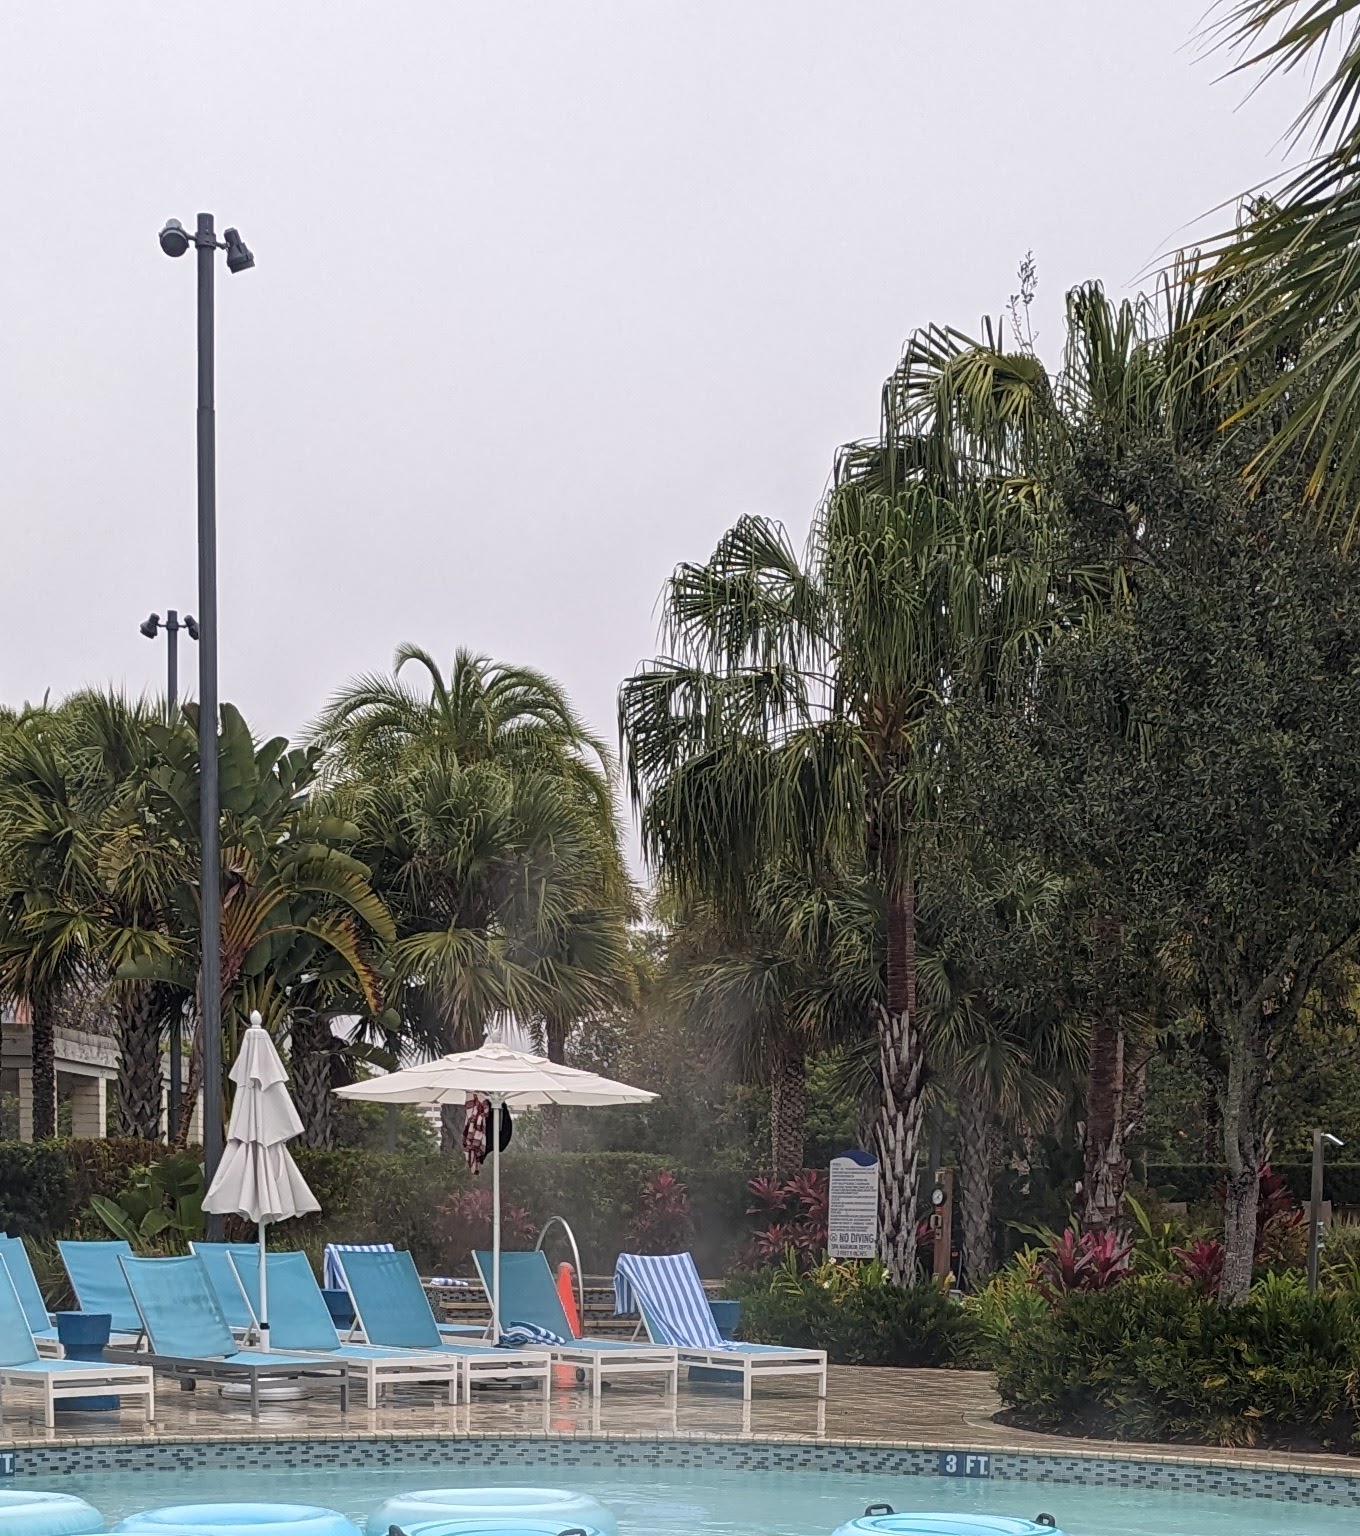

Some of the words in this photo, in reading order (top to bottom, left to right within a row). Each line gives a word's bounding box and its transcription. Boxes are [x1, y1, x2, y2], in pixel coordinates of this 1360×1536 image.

[839, 1233, 849, 1243] NO
[850, 1233, 874, 1243] DIVING
[946, 1454, 958, 1473] 3
[965, 1455, 989, 1475] FT.
